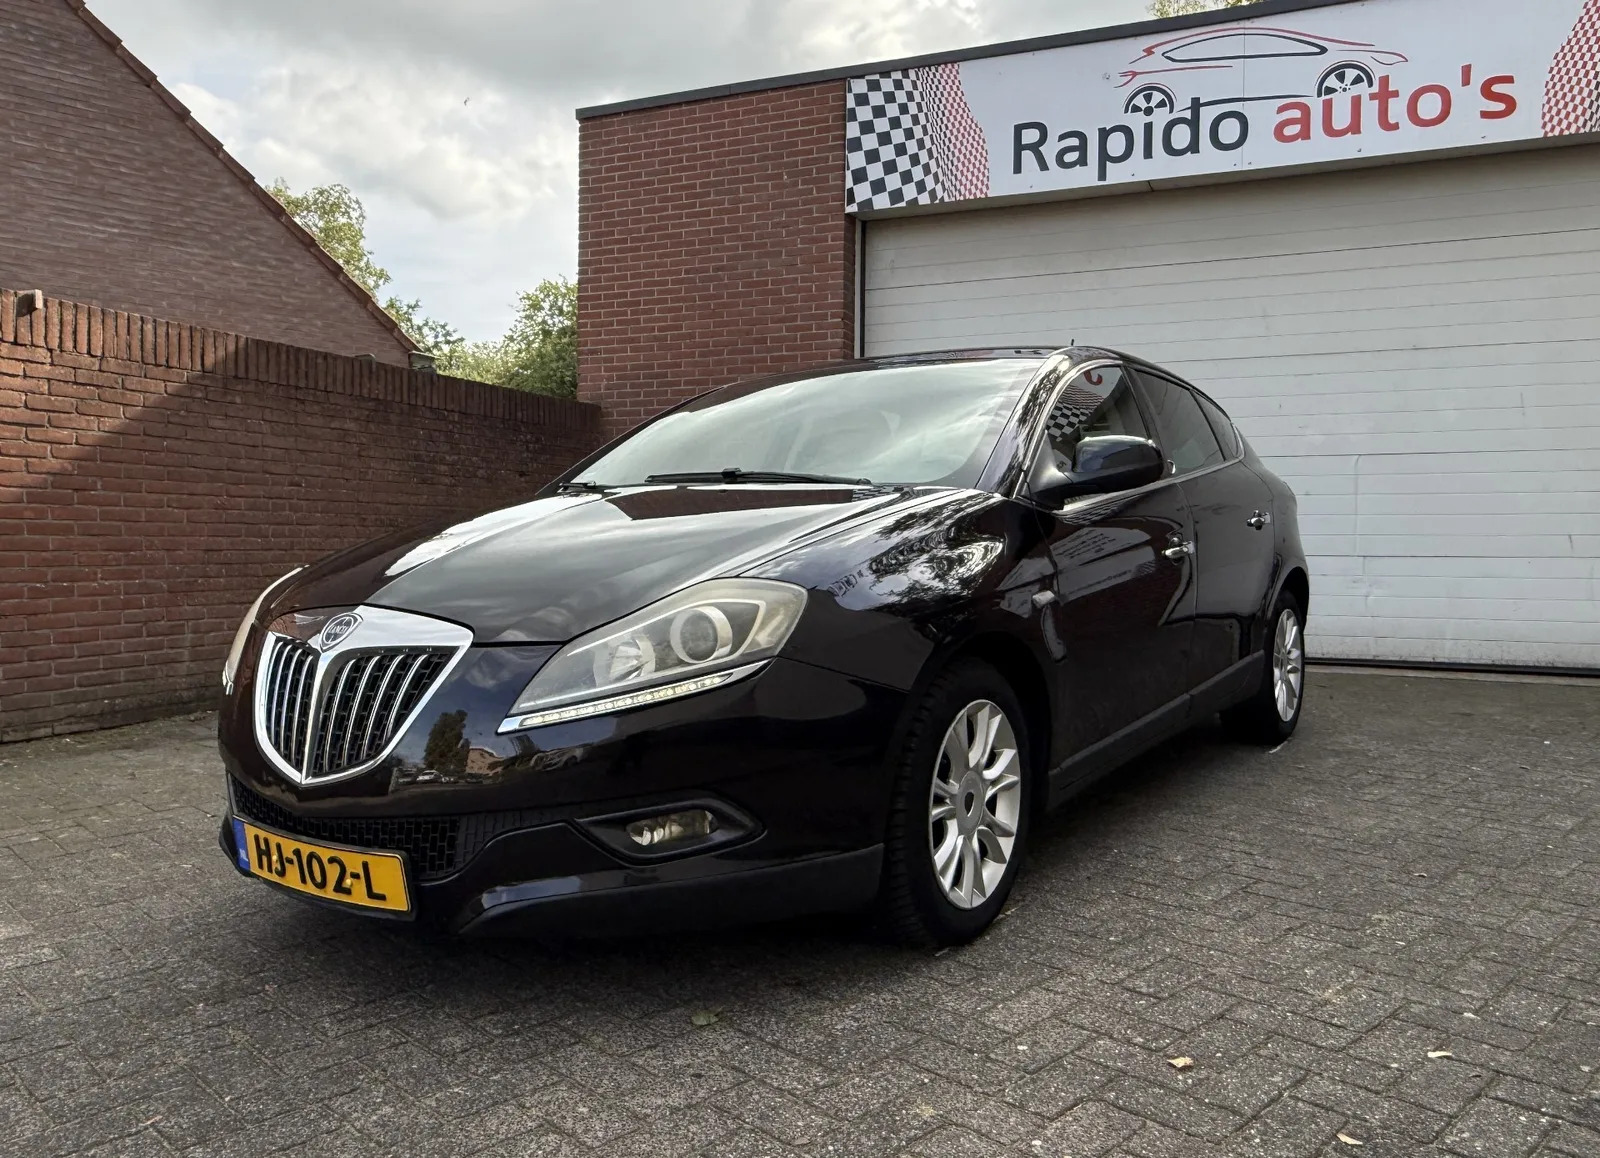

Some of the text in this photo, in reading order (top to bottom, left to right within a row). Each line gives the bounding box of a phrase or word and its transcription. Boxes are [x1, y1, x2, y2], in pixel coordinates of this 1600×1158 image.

[1012, 63, 1517, 181] Rapido auto's
[253, 833, 387, 901] HJ-102-L
